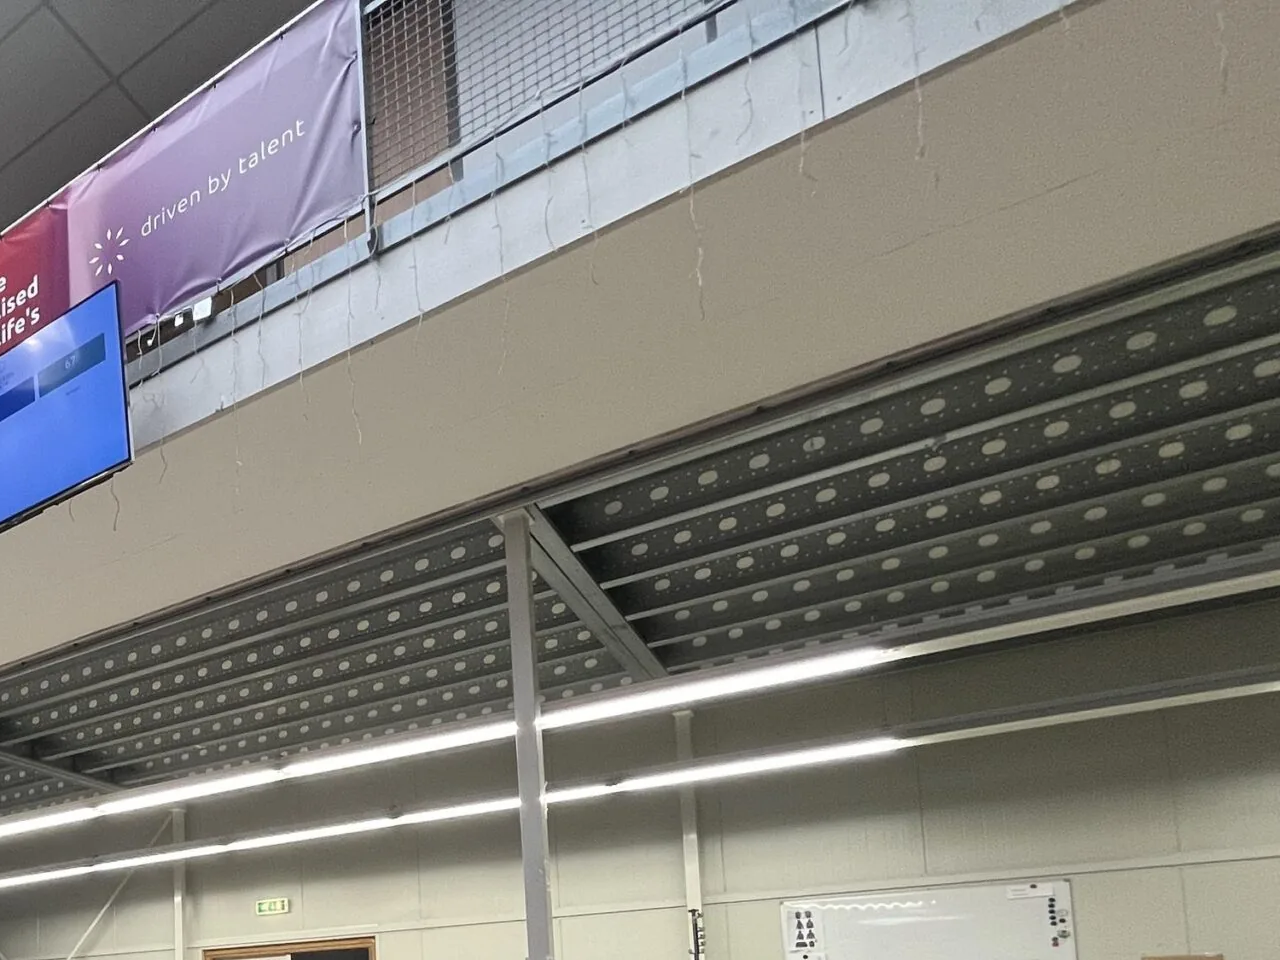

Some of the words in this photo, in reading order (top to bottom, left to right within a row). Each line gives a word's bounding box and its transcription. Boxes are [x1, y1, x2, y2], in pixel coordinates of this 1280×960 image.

[141, 190, 201, 236] driven
[208, 168, 231, 194] by
[238, 119, 305, 174] talent
